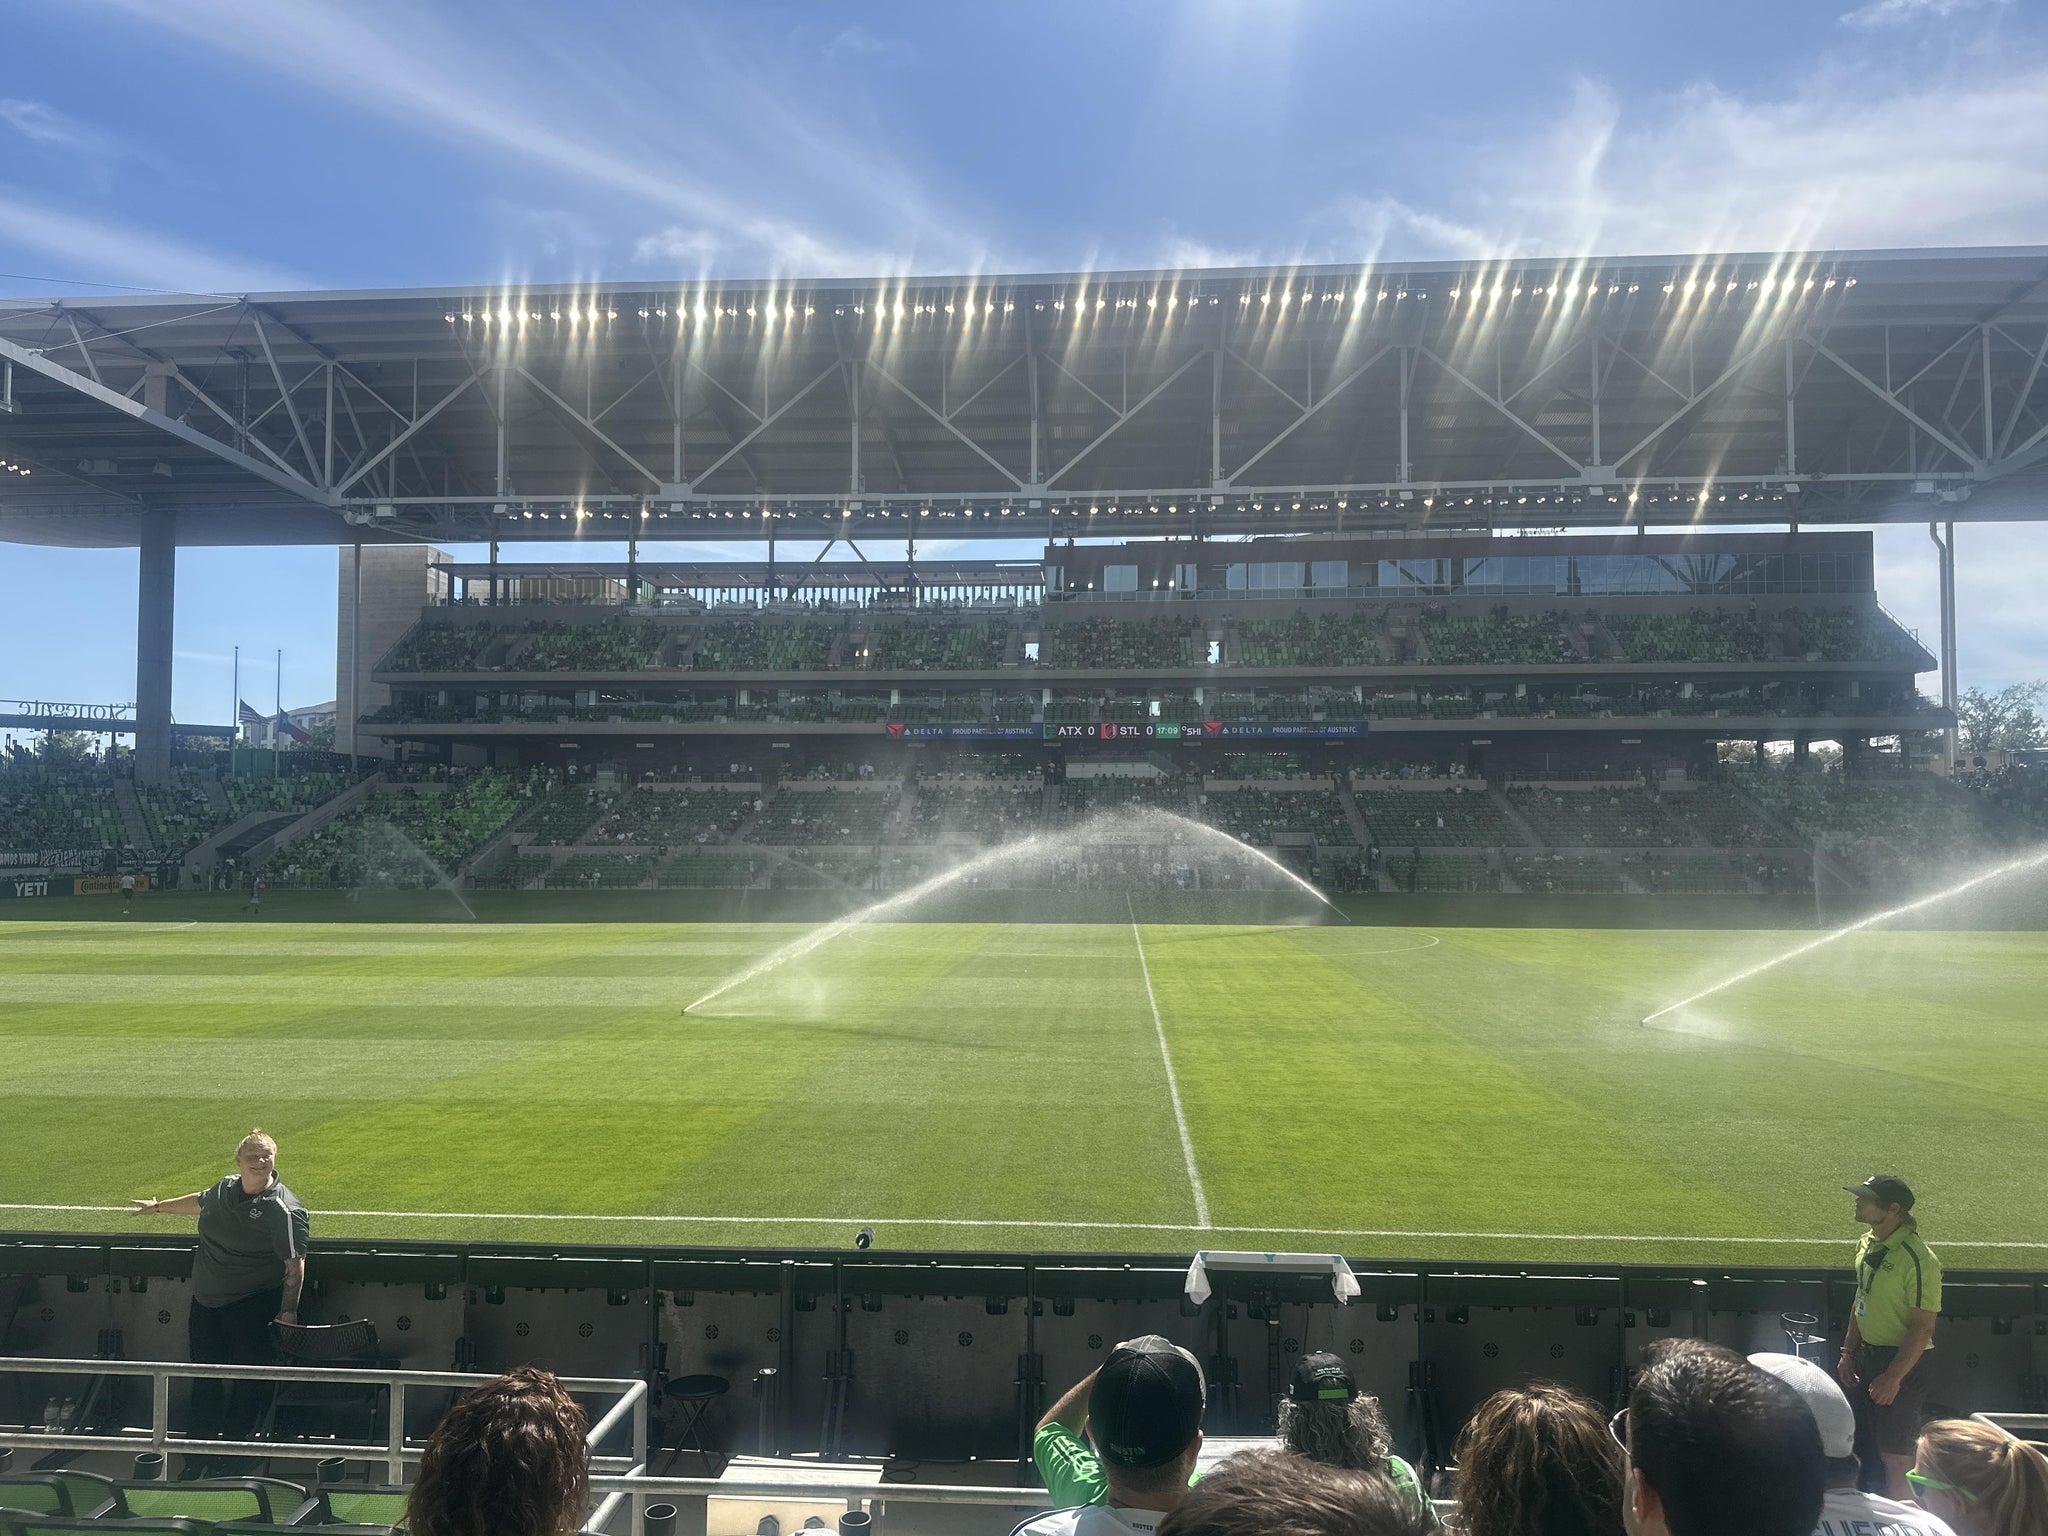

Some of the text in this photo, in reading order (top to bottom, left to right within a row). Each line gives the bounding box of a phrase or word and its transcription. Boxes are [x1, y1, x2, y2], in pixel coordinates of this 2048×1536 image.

[1058, 726, 1095, 736] ATX 0
[1119, 726, 1153, 736] STL 0
[1157, 727, 1179, 735] 17:09
[14, 881, 48, 897] YETI
[80, 880, 120, 893] Continenta
